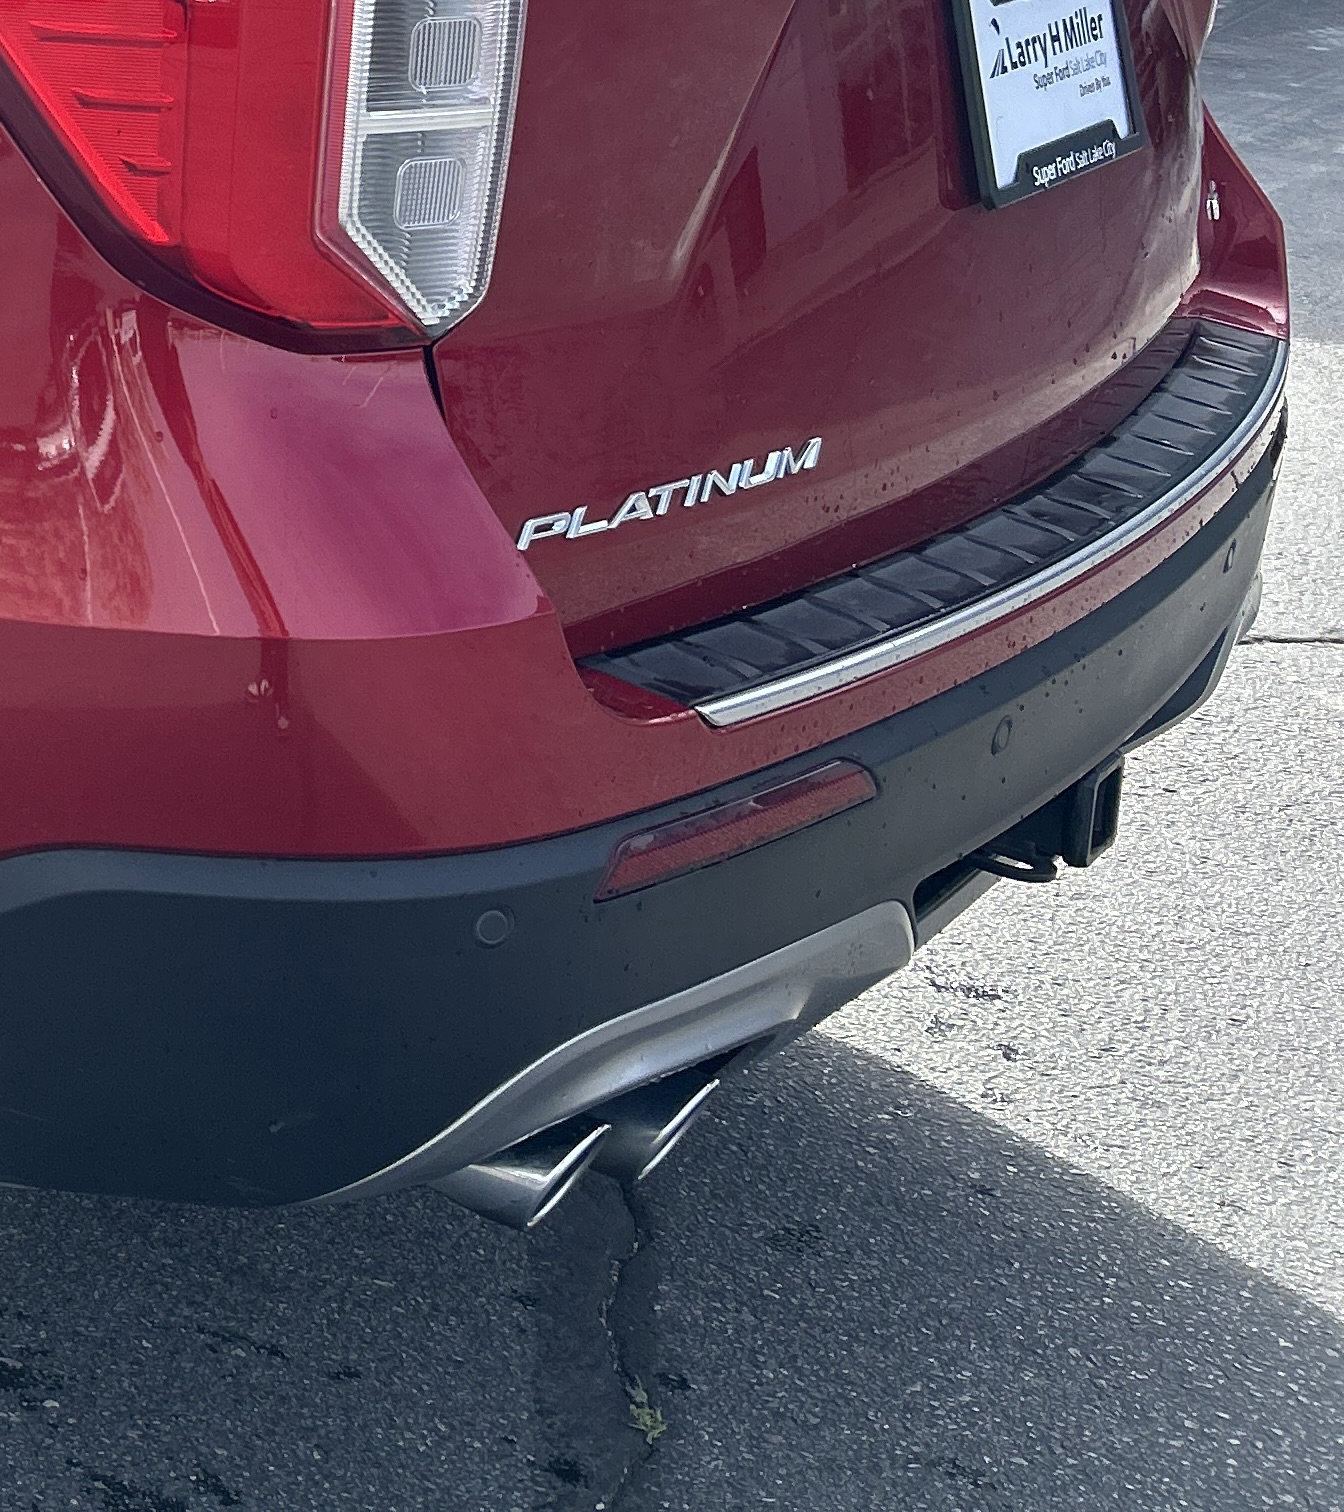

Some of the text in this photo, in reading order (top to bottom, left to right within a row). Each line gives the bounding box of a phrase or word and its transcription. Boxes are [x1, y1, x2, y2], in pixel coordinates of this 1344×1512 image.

[1005, 6, 1105, 71] Larry H Miller
[1033, 49, 1109, 92] Super Ford Salt Lake City
[1032, 139, 1117, 188] Super Ford Salt Lake City
[516, 436, 823, 551] PLATINUM
